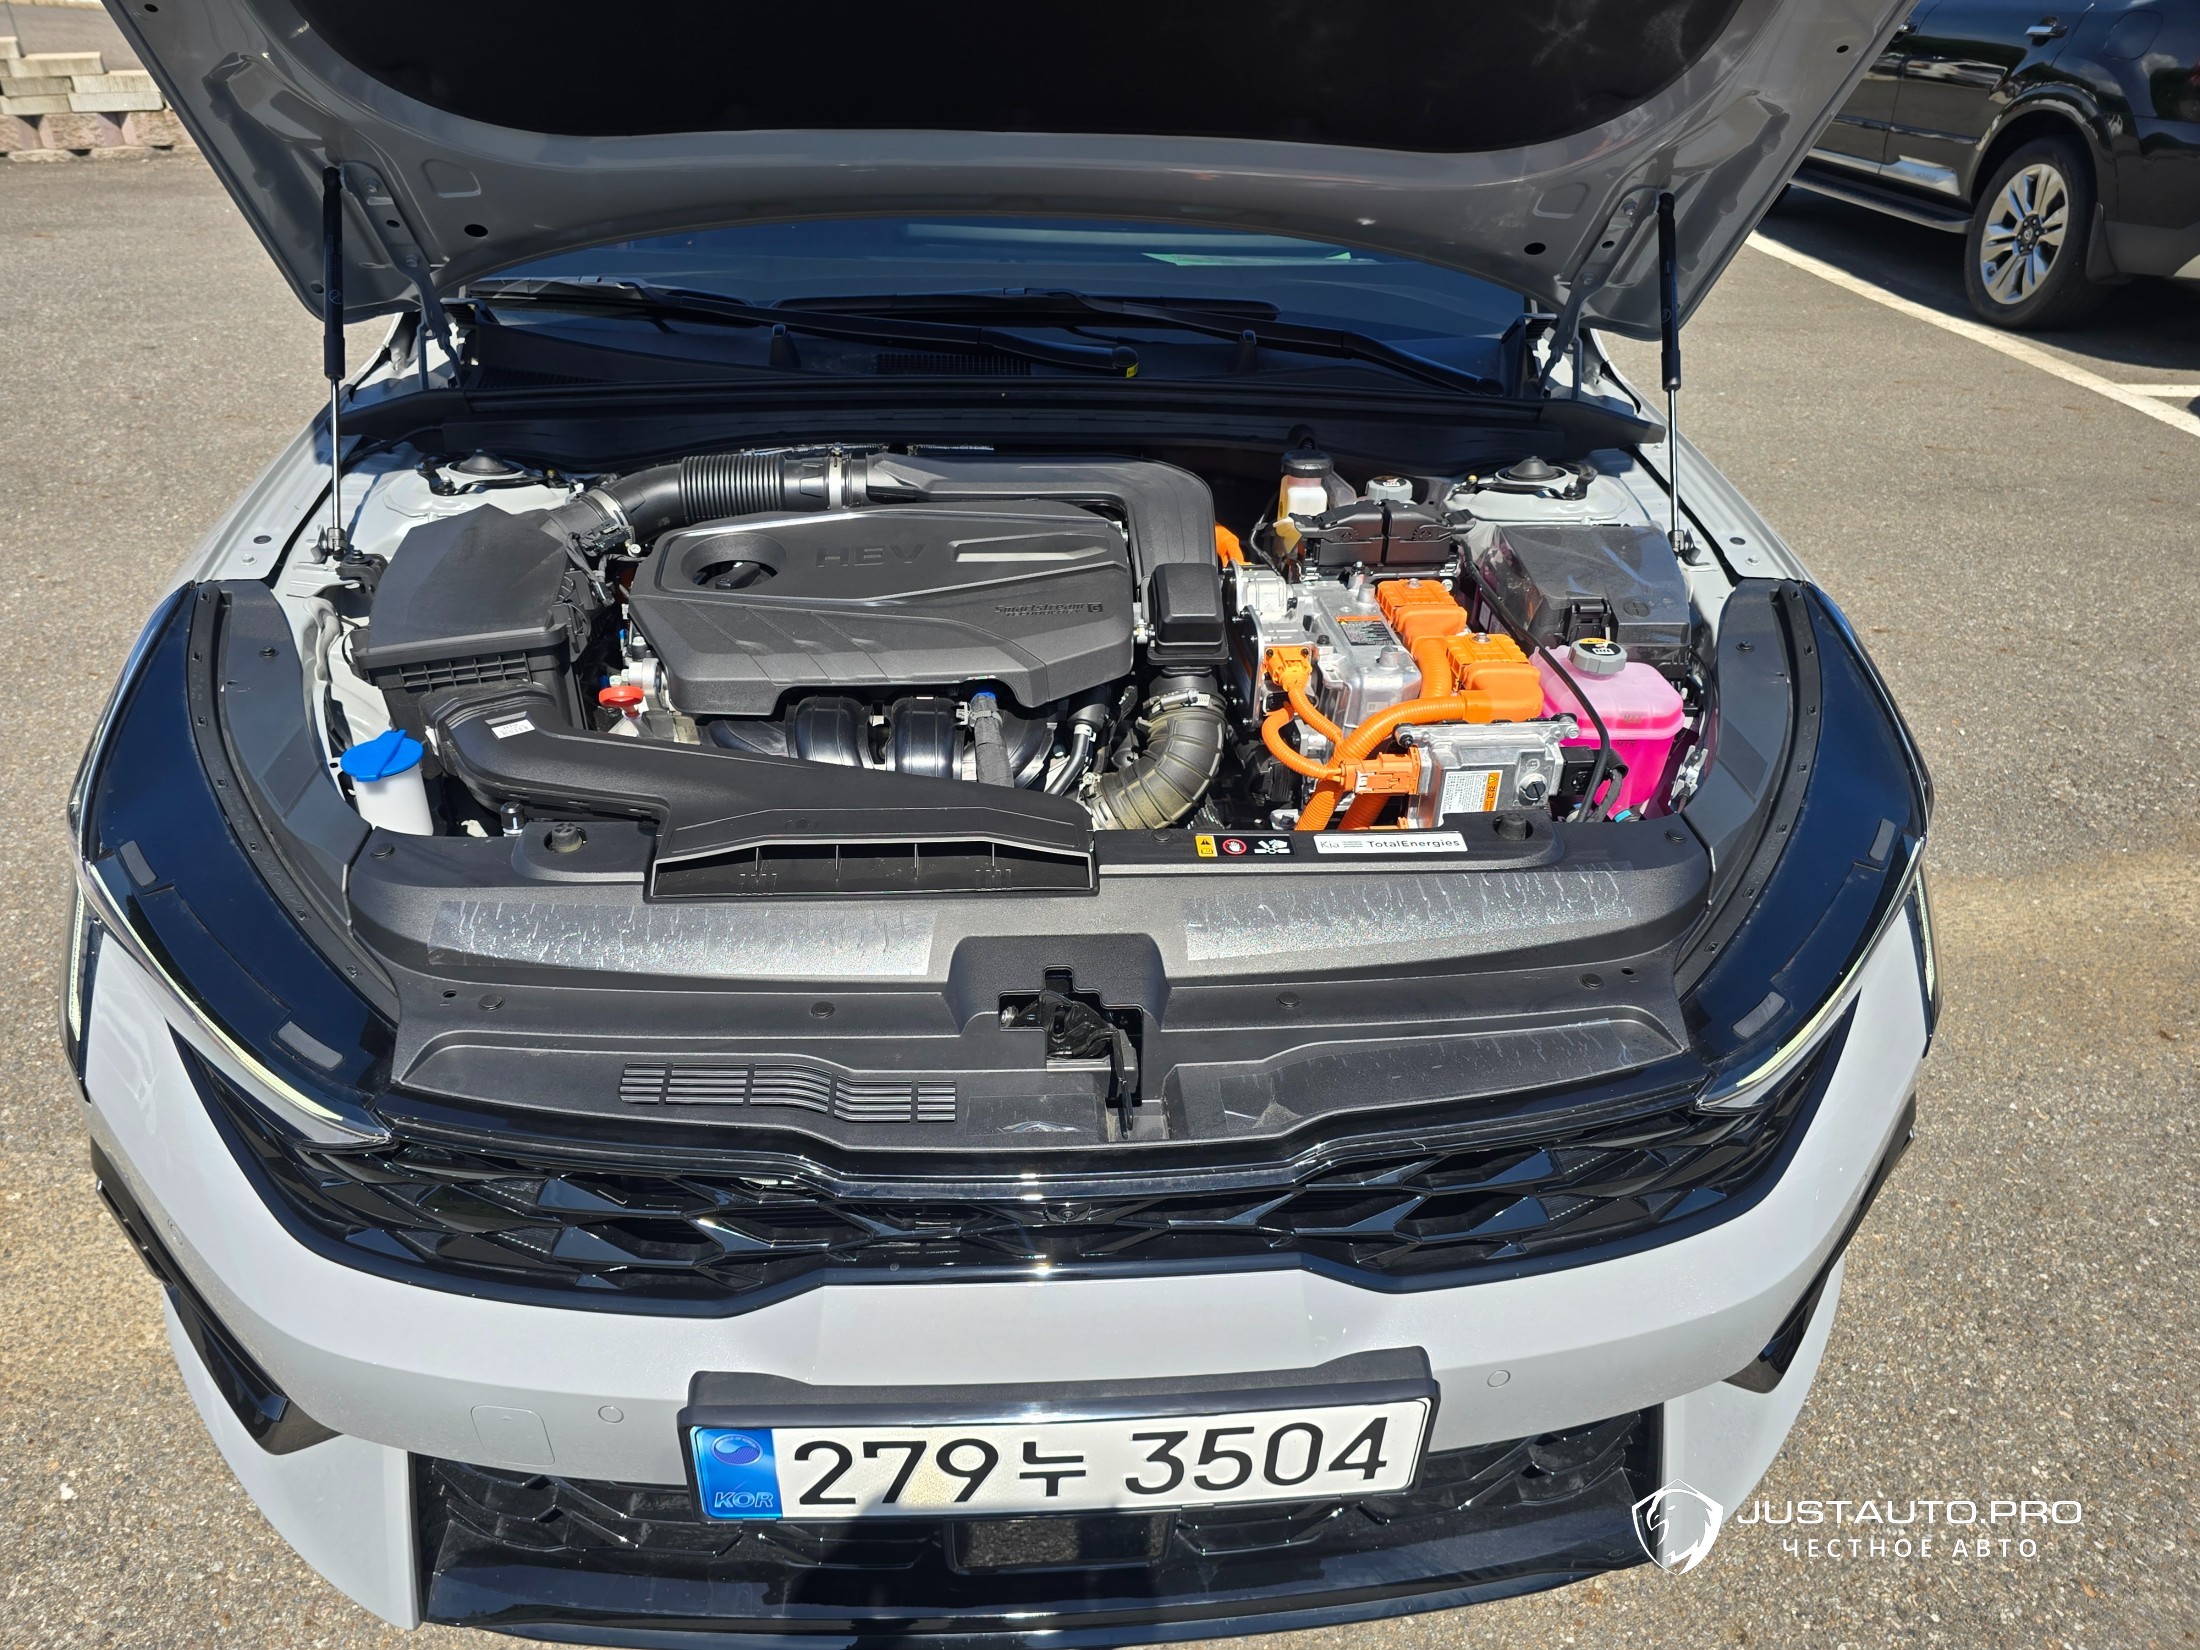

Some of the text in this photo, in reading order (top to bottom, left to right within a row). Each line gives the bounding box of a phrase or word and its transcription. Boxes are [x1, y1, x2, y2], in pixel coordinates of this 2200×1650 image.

[816, 544, 927, 567] HEV
[995, 603, 1084, 613] Smartstream
[1366, 839, 1460, 848] TotalEnergies
[1125, 1417, 1388, 1494] 3504
[714, 1491, 774, 1508] KOR
